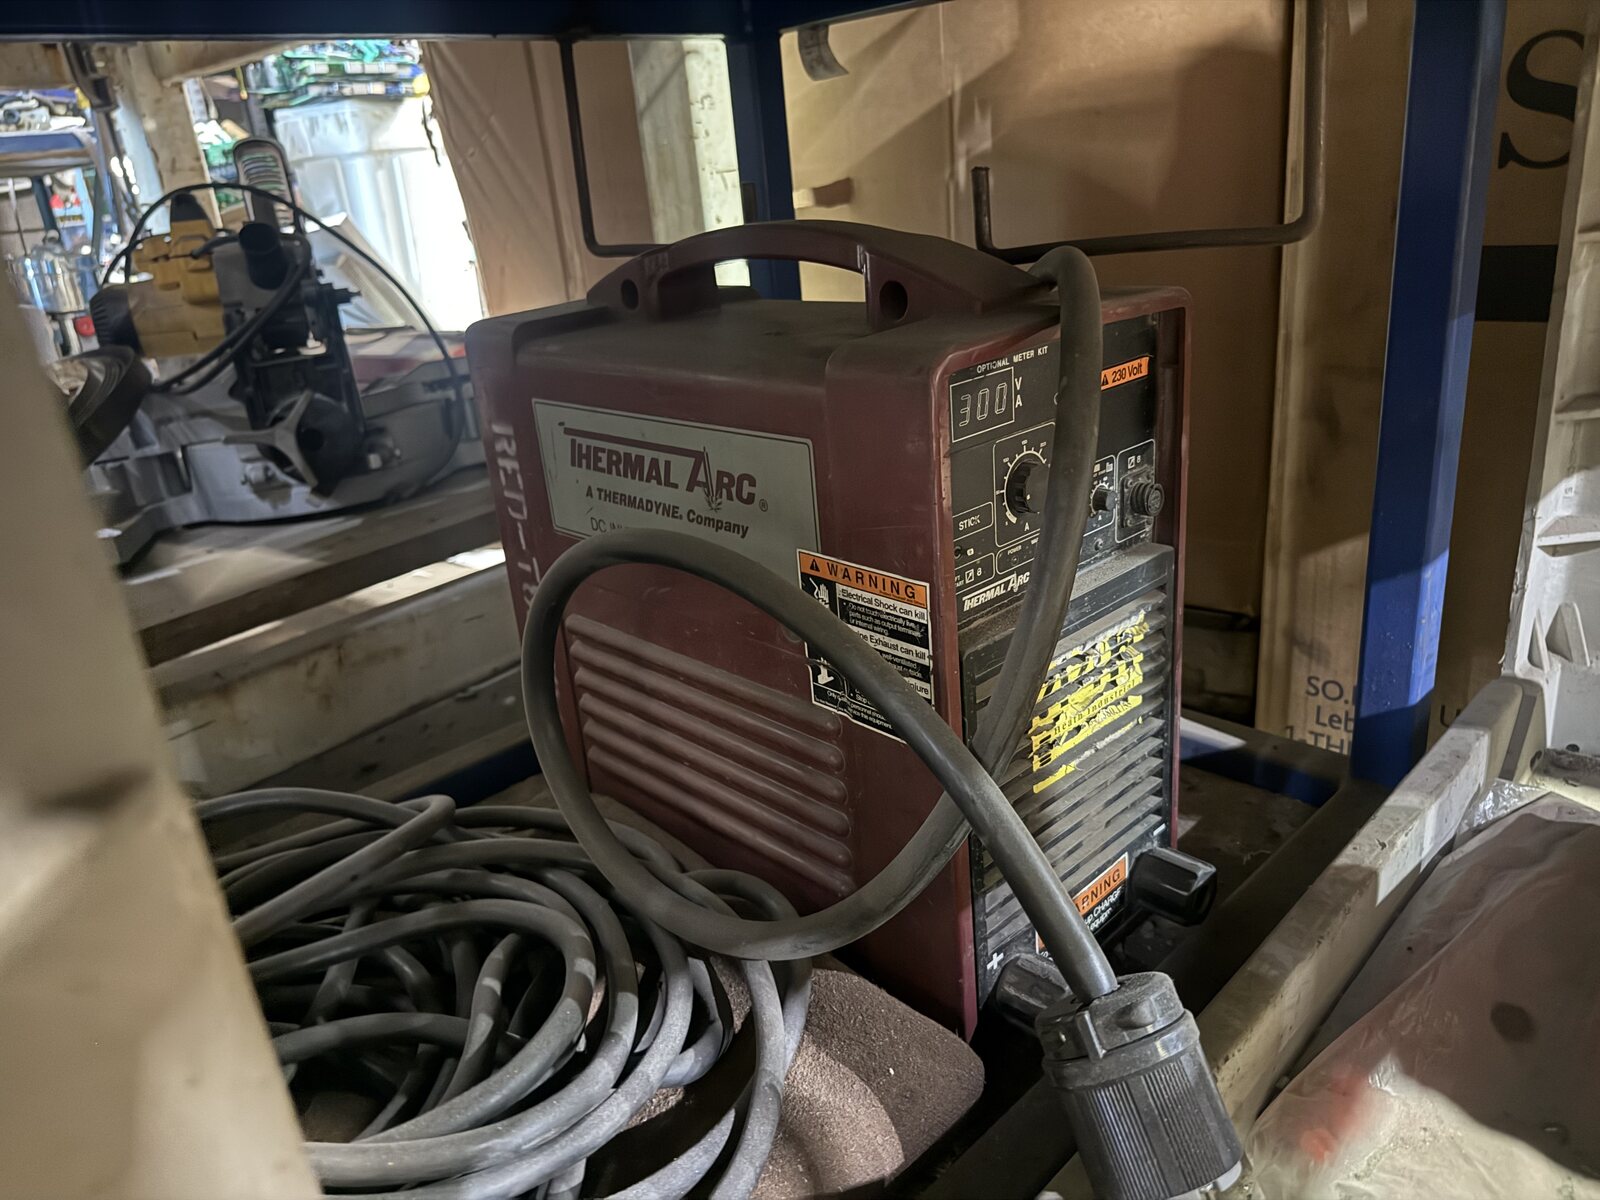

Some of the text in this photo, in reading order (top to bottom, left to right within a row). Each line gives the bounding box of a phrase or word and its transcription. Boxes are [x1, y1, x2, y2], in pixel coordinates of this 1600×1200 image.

[976, 345, 1049, 374] OPTIONAL METER KIT
[1111, 362, 1143, 383] 230 Volt
[1014, 377, 1023, 391] V
[958, 382, 1008, 427] 300
[1015, 394, 1023, 408] A
[563, 427, 757, 507] THERMAL ARC
[585, 485, 594, 499] A
[686, 508, 750, 539] Company
[590, 517, 607, 533] DC
[958, 514, 981, 531] STICK
[1024, 522, 1030, 532] A
[827, 562, 916, 600] WARNING
[962, 571, 1031, 612] THERMAL ARC
[841, 588, 873, 606] Electrical
[874, 598, 898, 612] Shock
[899, 607, 913, 618] can
[869, 634, 899, 652] Exhaust
[899, 646, 914, 657] can
[914, 649, 926, 661] kill
